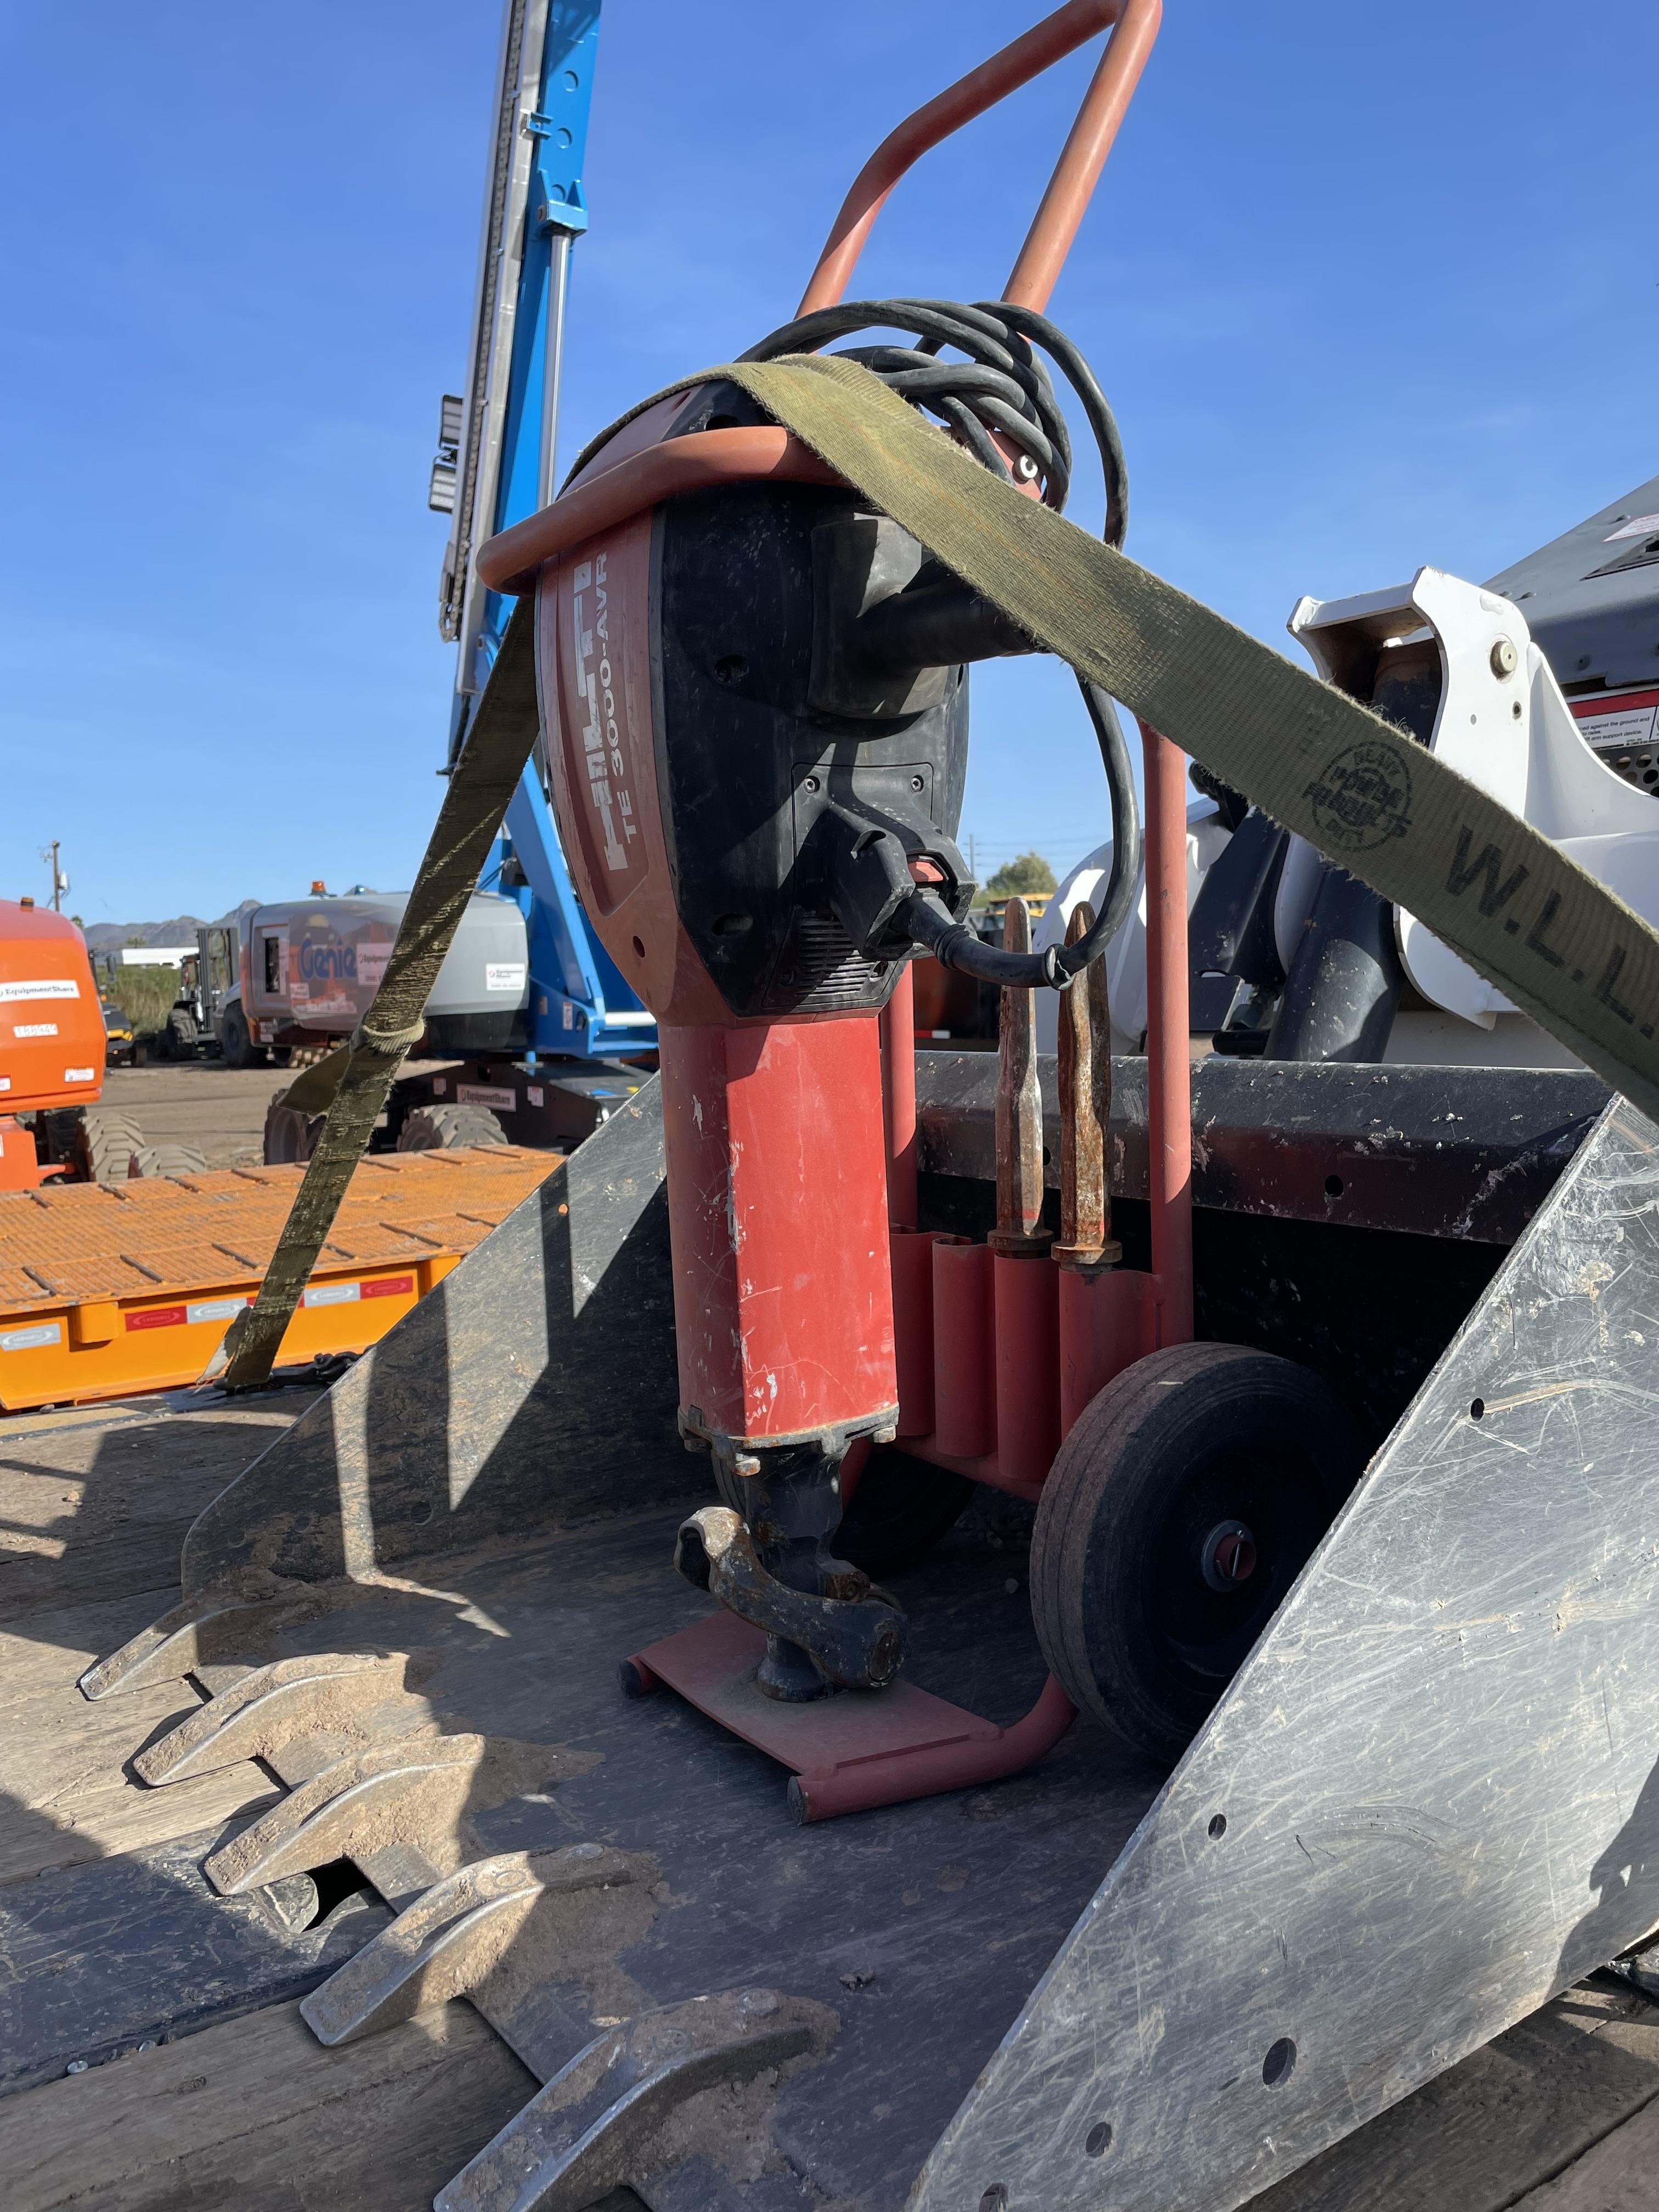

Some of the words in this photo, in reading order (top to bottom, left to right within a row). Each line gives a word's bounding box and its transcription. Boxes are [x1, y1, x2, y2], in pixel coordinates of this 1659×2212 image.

[573, 561, 628, 871] HILTI
[596, 551, 625, 777] 3000-AVR
[617, 789, 637, 844] TE
[300, 938, 357, 979] Genie
[1444, 825, 1655, 1040] W.L.L.
